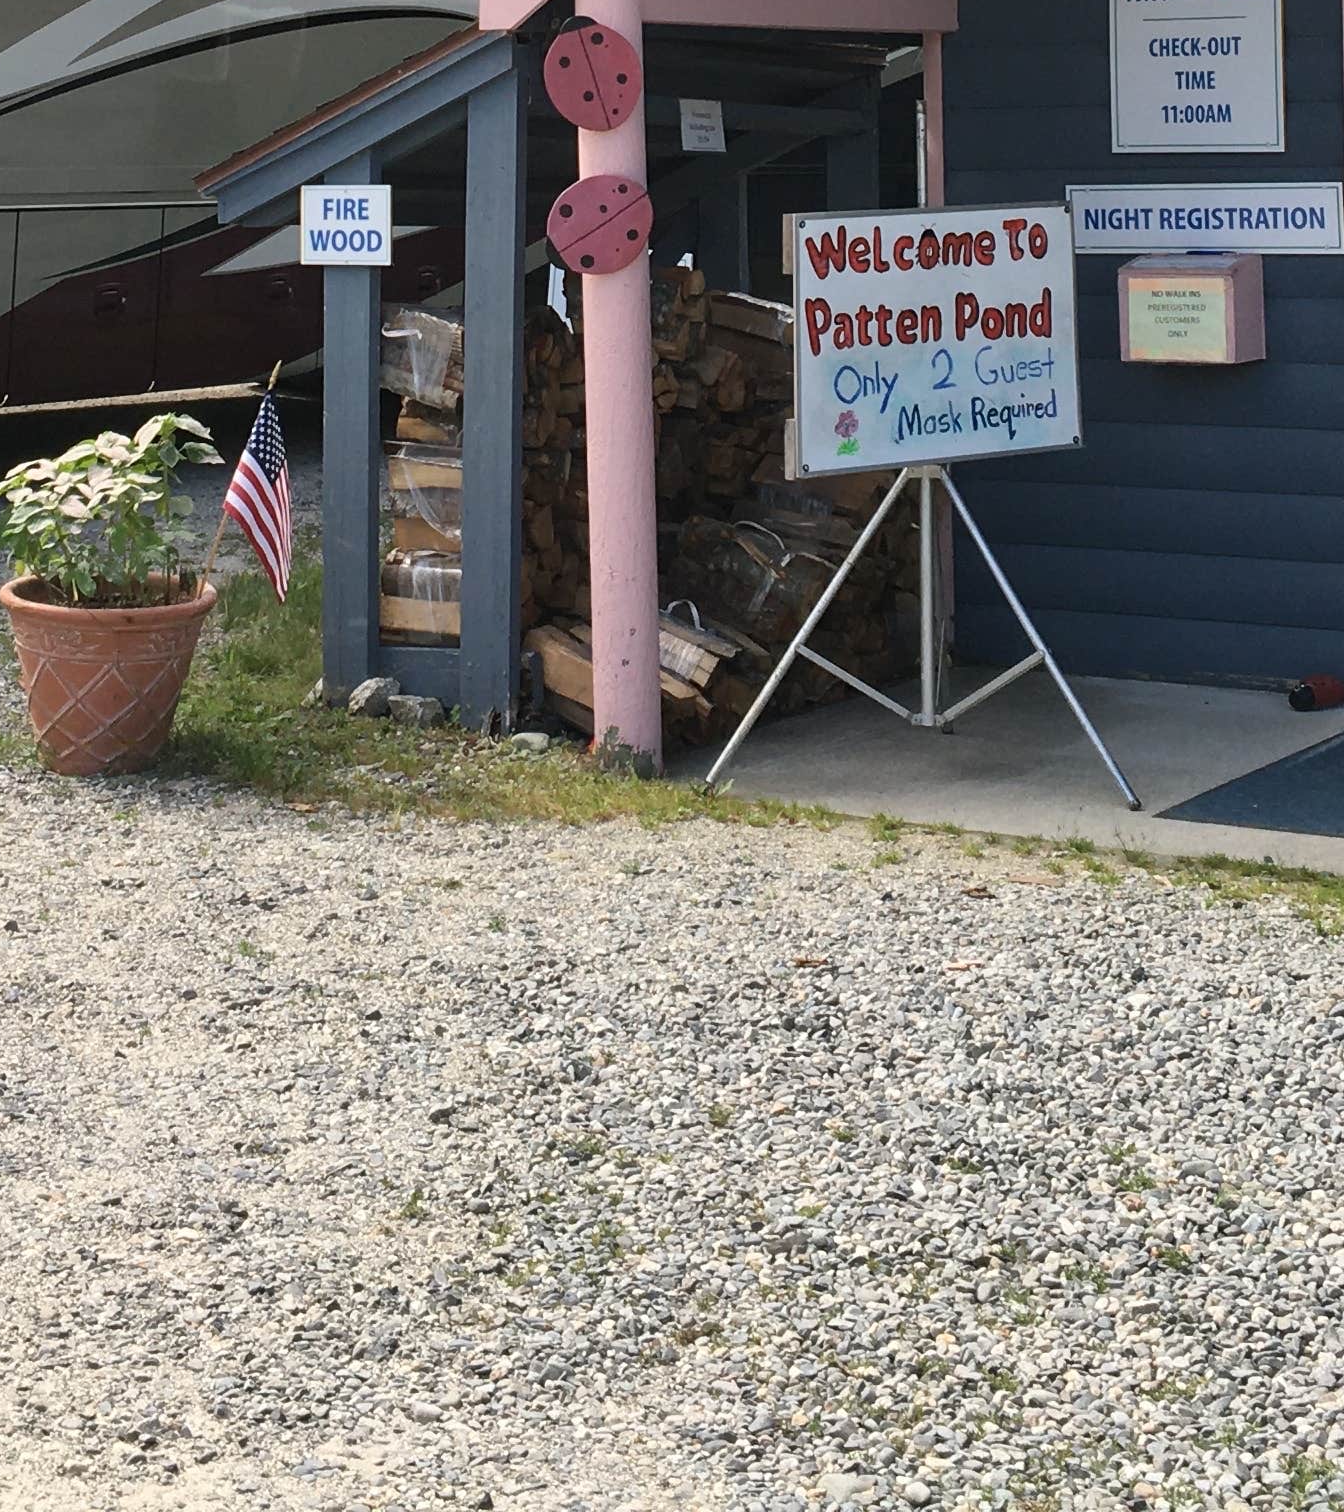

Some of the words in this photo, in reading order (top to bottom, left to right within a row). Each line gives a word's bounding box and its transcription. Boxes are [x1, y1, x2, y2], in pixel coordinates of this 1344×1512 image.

[1149, 36, 1241, 57] CHECK-OUT
[1175, 70, 1216, 90] TIME
[1161, 104, 1232, 124] 11:00AM
[323, 198, 369, 221] FIRE
[1084, 208, 1153, 230] NIGHT
[1160, 207, 1326, 230] REGISTRATION
[309, 229, 383, 253] WOOD
[805, 224, 996, 280] Welcome
[1002, 218, 1049, 261] To
[805, 297, 943, 357] Patten
[955, 287, 1053, 342] Pond
[1168, 330, 1188, 338] ONLY
[834, 361, 898, 414] Only
[931, 347, 957, 390] 2
[974, 345, 1055, 386] Guest
[896, 399, 963, 441] Mask
[971, 389, 1058, 440] Required
